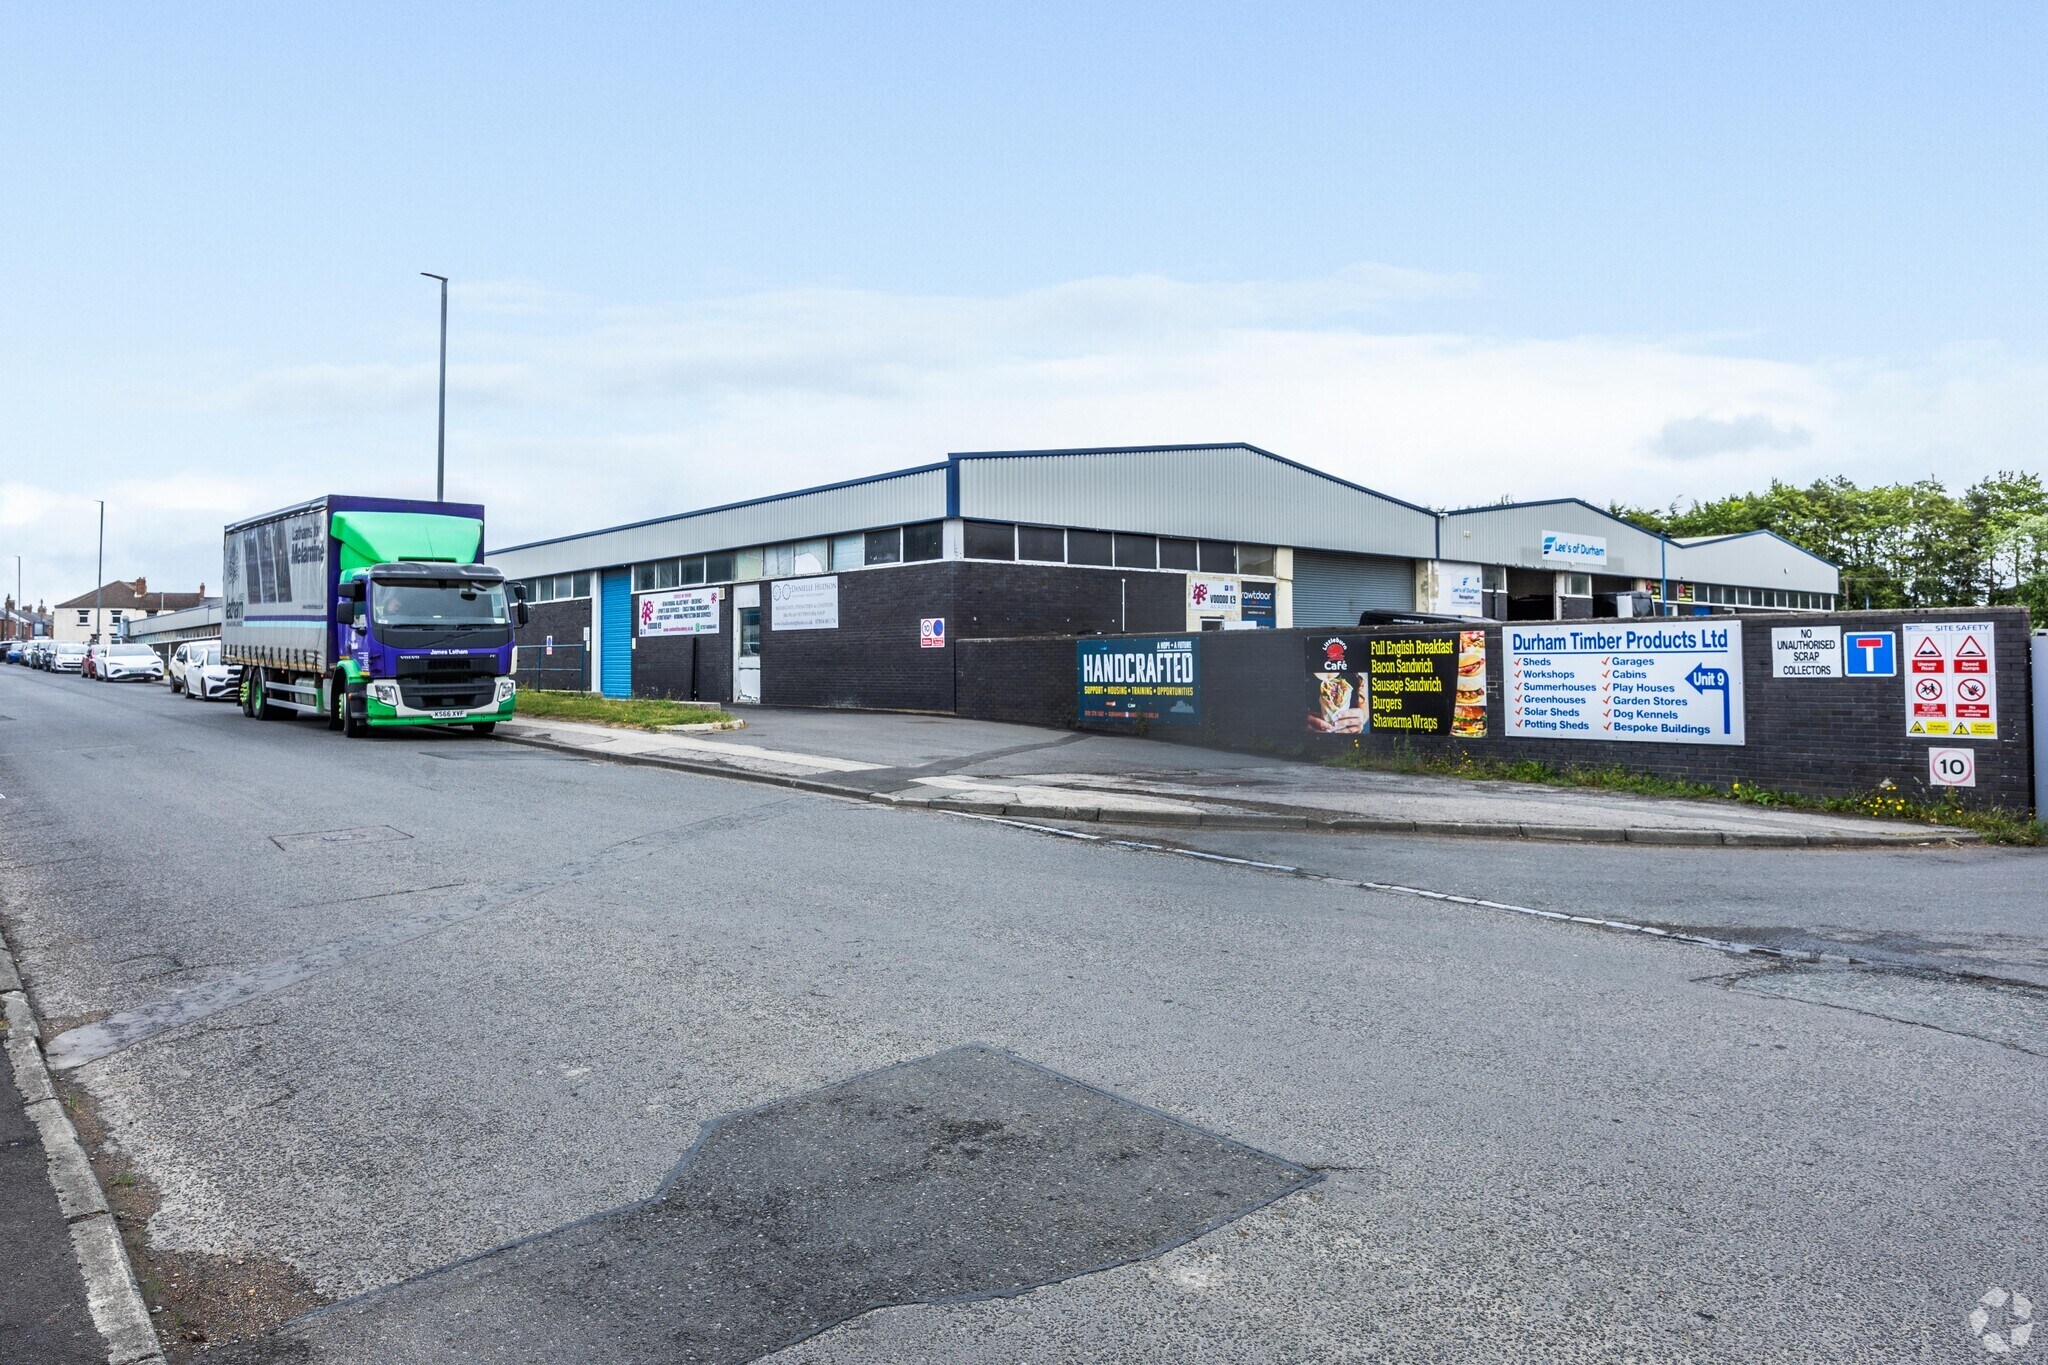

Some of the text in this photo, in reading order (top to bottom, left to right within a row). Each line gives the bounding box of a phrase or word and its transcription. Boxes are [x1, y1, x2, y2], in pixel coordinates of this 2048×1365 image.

[1554, 542, 1604, 556] Lee's of Durham
[792, 582, 836, 592] DANIELLE HUDSON
[1210, 594, 1228, 604] VOODOO
[1230, 595, 1236, 604] K9
[1242, 590, 1272, 600] rawtdoor
[1801, 629, 1812, 638] NO
[1322, 637, 1348, 651] Littleburn
[1513, 629, 1728, 650] Durham Timber Products Ltd
[1371, 639, 1453, 657] Full English Breakfast
[1777, 640, 1835, 650] UNAUTHORISED
[1794, 652, 1820, 661] SCRAP
[1324, 660, 1347, 671] Café
[1371, 658, 1433, 673] Bacon Sandwich
[1523, 658, 1551, 666] Sheds
[1612, 657, 1654, 667] Garages
[1083, 653, 1193, 683] HANDCRAFTED
[1783, 665, 1831, 675] COLLECTORS
[1523, 670, 1575, 680] Workshops
[1612, 669, 1647, 679] Cabins
[1693, 672, 1725, 686] Unit 9
[1372, 677, 1442, 694] Sausage Sandwich
[1524, 682, 1596, 691] Summerhouses
[1612, 683, 1675, 694] Play Houses
[1084, 686, 1194, 696] SUPPORT HOUSING TRAINING OPPORTUNITIES
[1372, 696, 1402, 712] Burgers
[1524, 694, 1586, 704] Greenhouses
[1613, 696, 1688, 706] Garden Stores
[1524, 707, 1580, 716] Solar Sheds
[1613, 709, 1678, 720] Dog Kennels
[1373, 714, 1438, 732] Shawarma Wraps
[1524, 720, 1589, 730] Potting Sheds
[1614, 722, 1710, 735] Bespoke Buildings
[1940, 759, 1965, 774] 10
